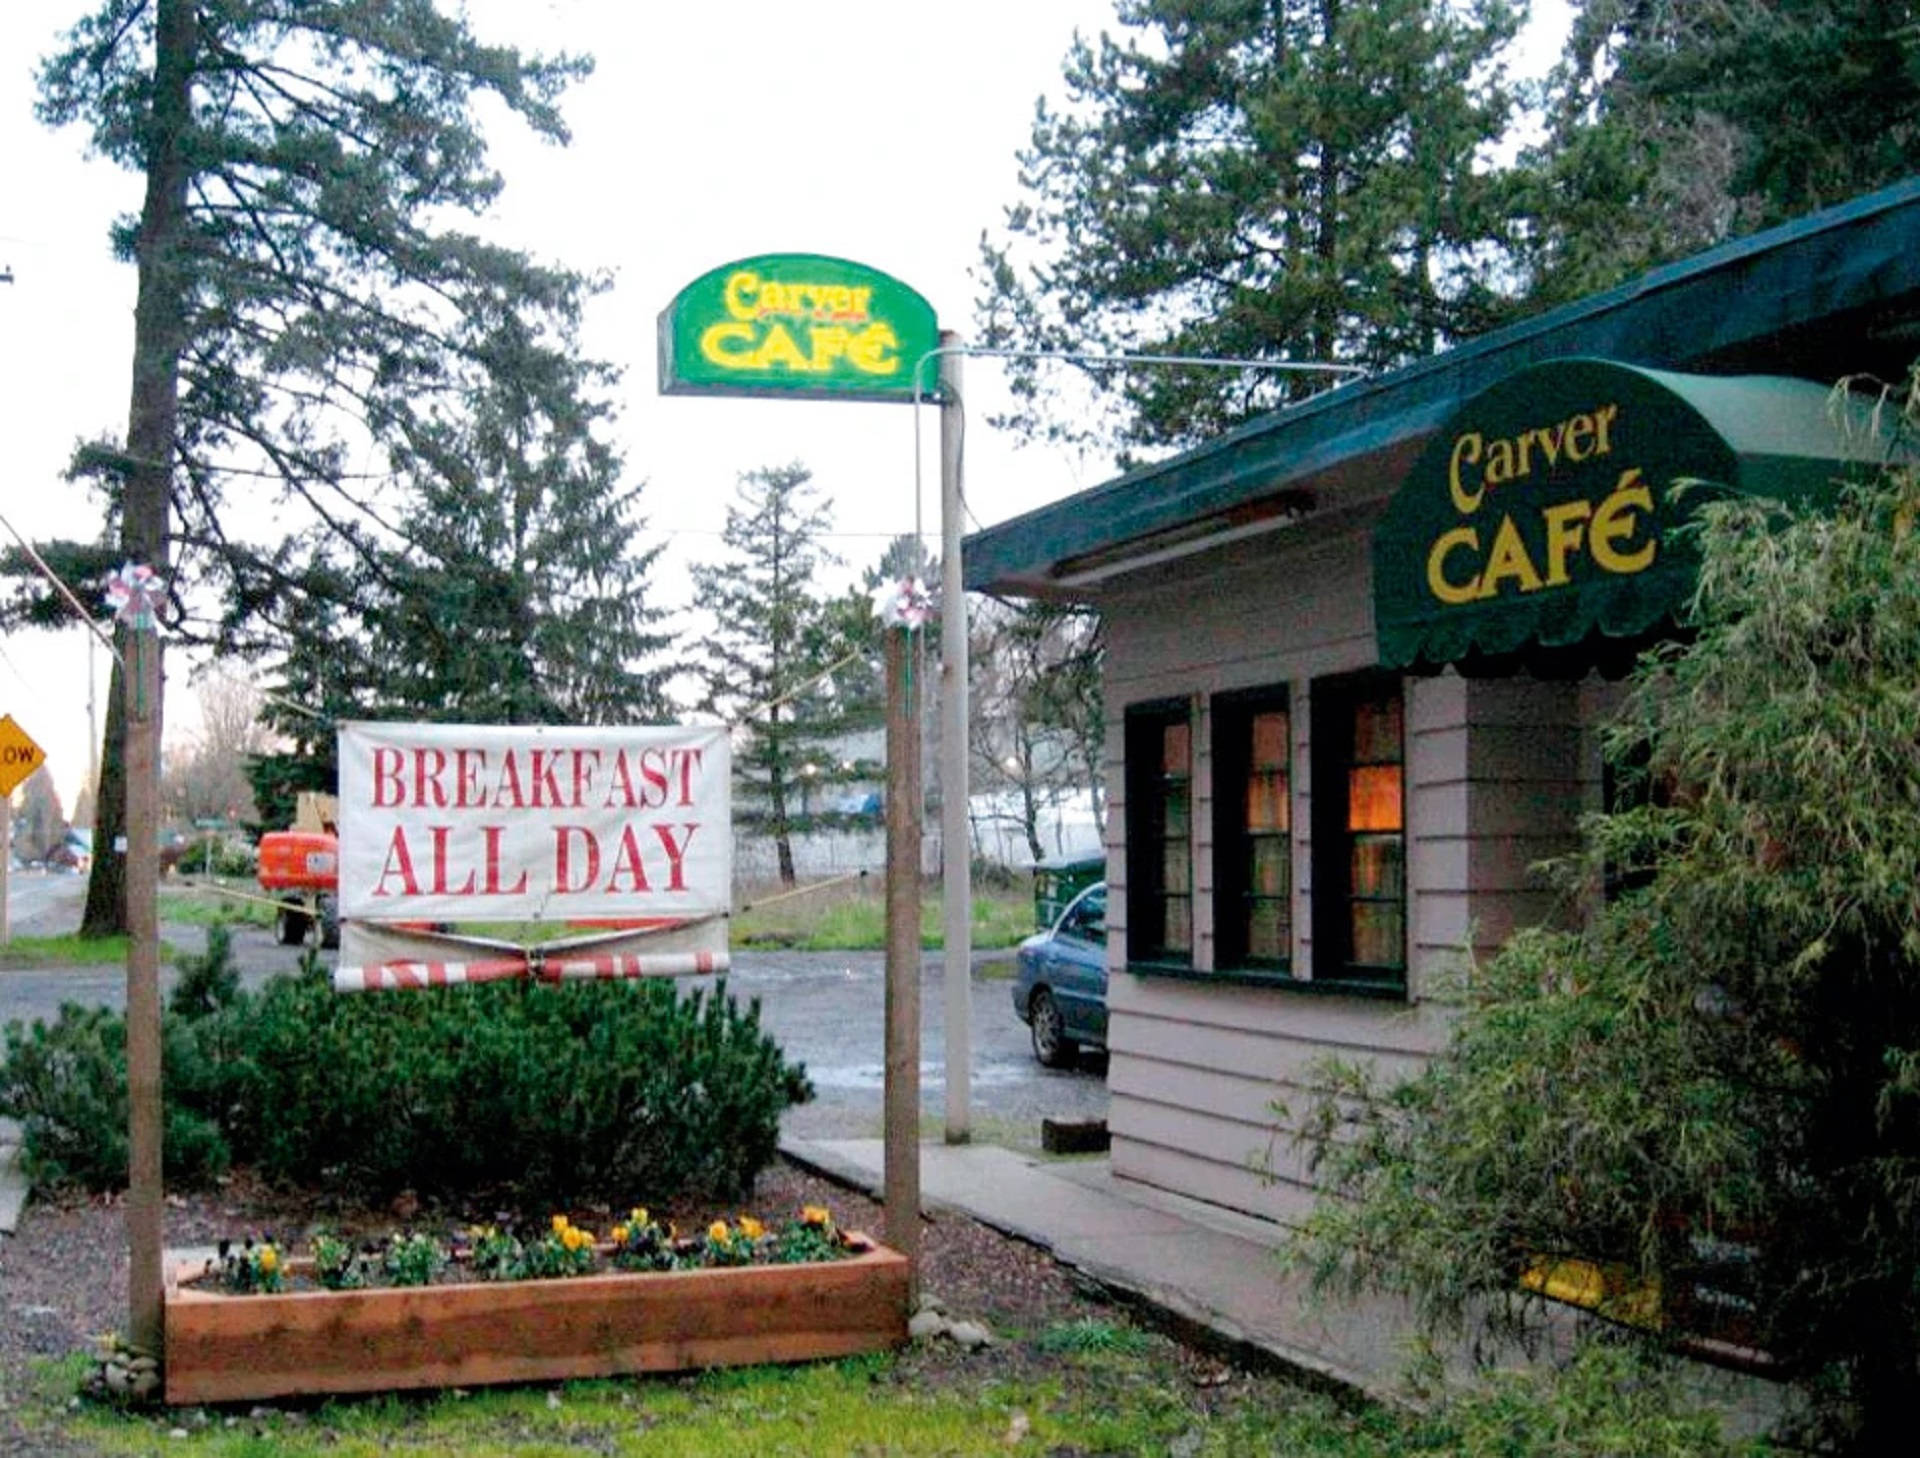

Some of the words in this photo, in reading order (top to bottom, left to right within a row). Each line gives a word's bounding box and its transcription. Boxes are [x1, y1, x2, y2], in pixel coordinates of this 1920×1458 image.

[725, 271, 871, 320] Carver
[1450, 402, 1618, 514] Carver
[1427, 468, 1656, 603] CAFÉ
[372, 747, 702, 808] BREAKFAST
[374, 824, 527, 895] ALL
[553, 824, 699, 893] DAY
